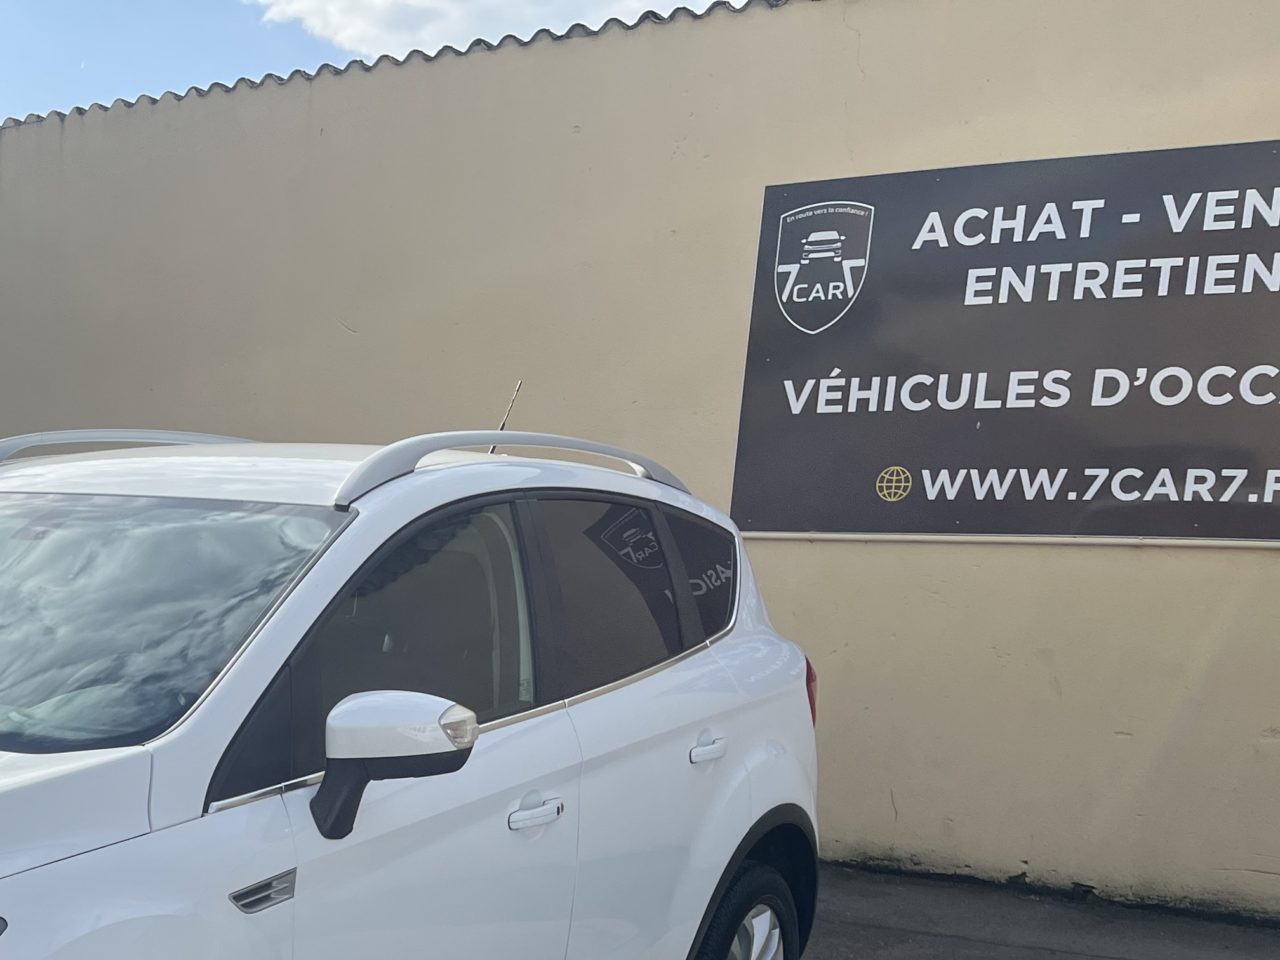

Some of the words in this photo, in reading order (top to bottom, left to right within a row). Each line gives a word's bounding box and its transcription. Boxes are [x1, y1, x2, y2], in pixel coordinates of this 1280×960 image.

[795, 211, 813, 220] route
[835, 207, 865, 216] confiance
[911, 199, 1106, 250] ACHAT
[1162, 187, 1280, 233] VEN
[964, 252, 1280, 306] ENTRETIEN
[783, 367, 1072, 414] VÉHICULES
[1090, 364, 1280, 407] D'OCC
